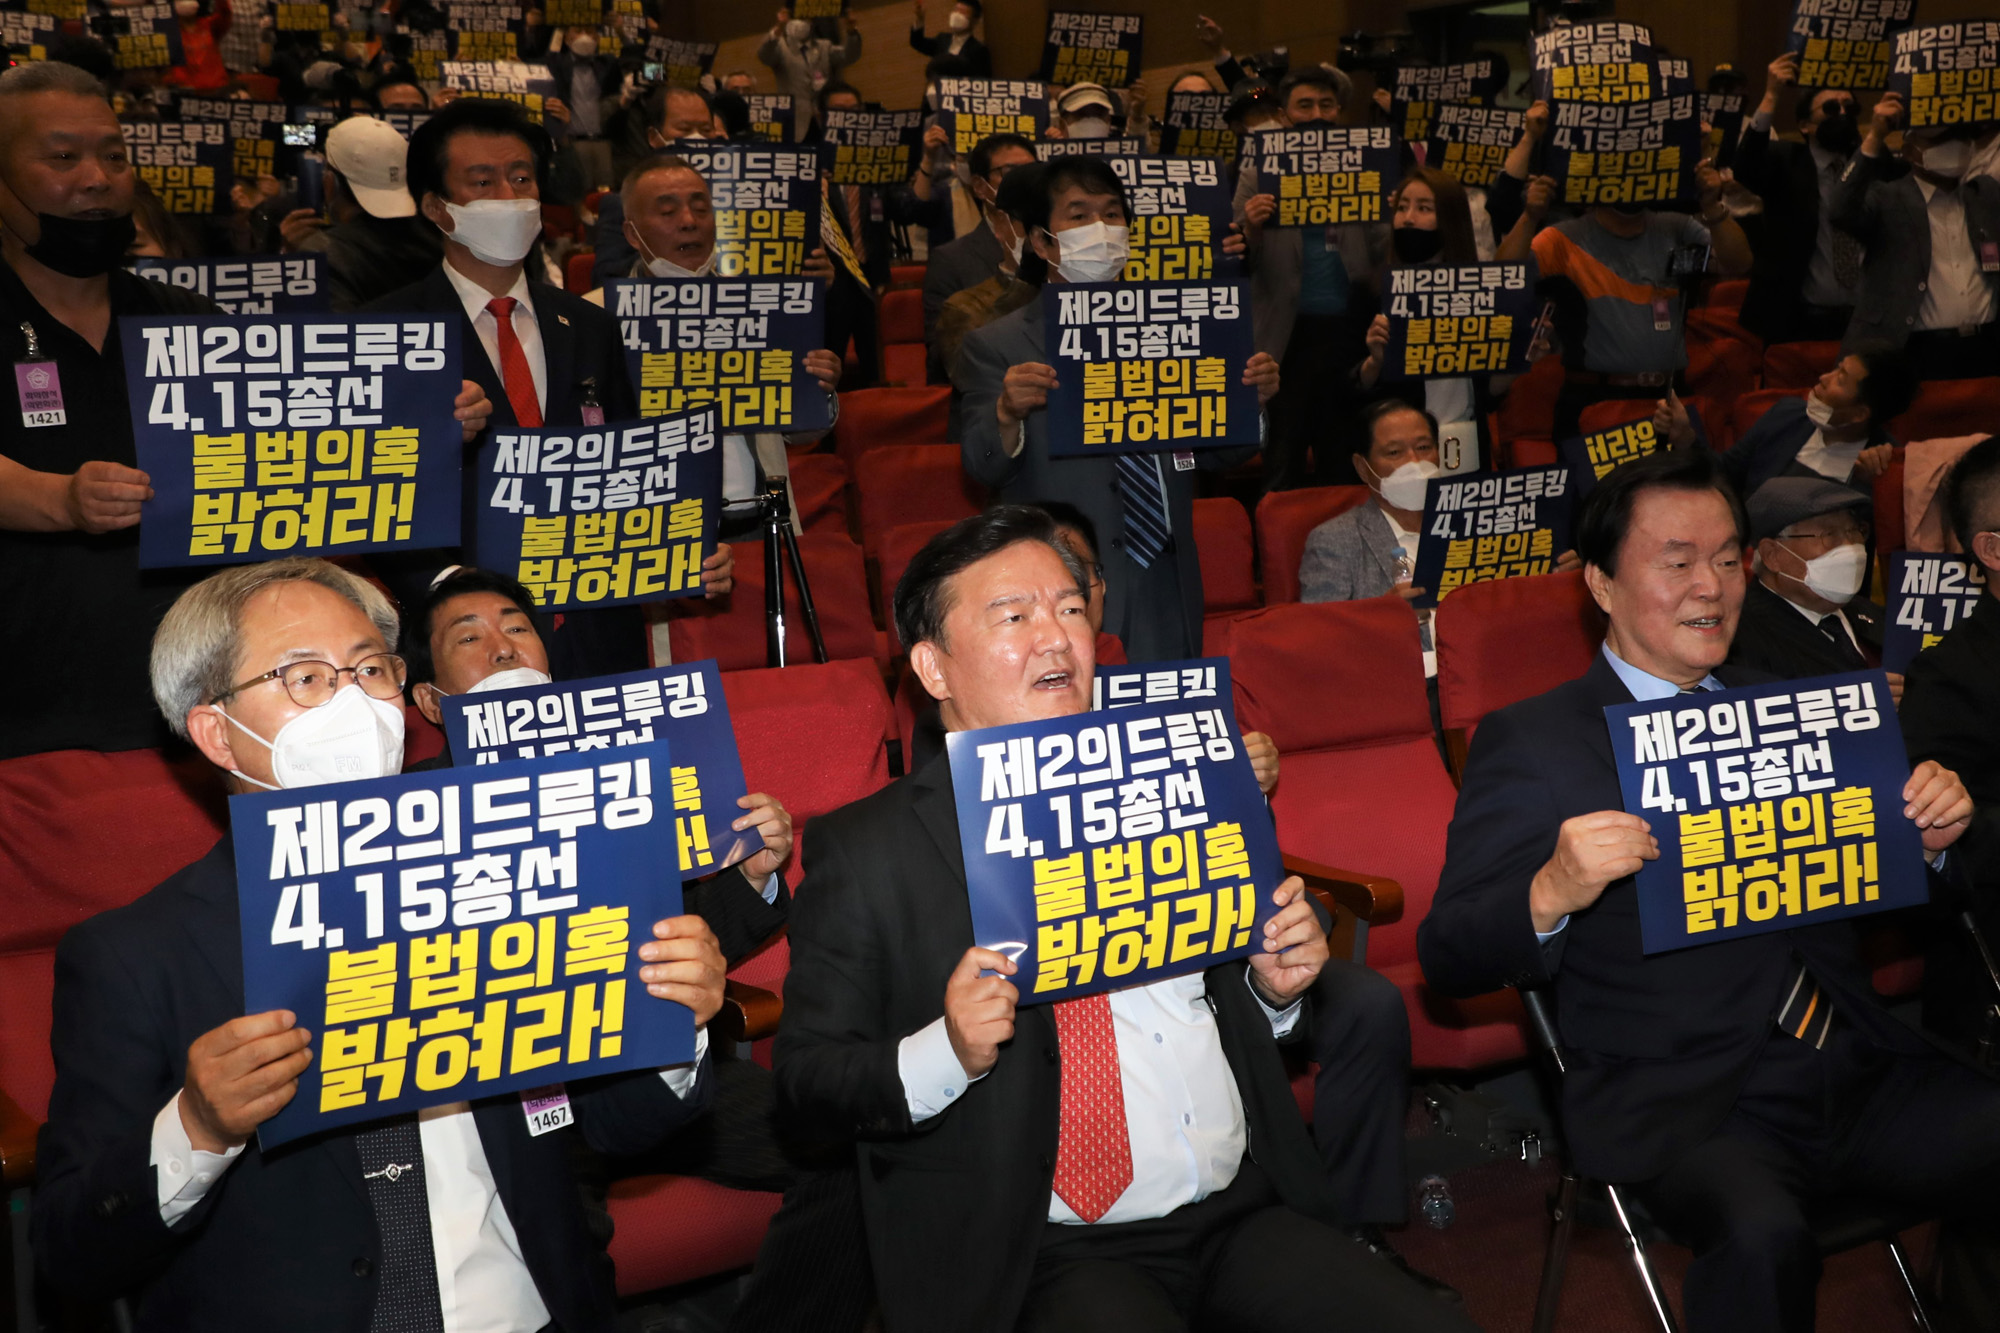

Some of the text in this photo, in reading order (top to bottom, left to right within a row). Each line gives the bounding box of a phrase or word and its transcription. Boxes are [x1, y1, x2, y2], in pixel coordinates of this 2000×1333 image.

[1793, 17, 1886, 41] 4.15총선
[1536, 43, 1632, 71] 4.15총선
[1552, 62, 1650, 88] 불법의혹
[1798, 61, 1889, 88] 밝혀라!
[1894, 44, 1997, 74] 4.15총선
[942, 96, 1021, 115] 4.15총선
[955, 113, 1036, 133] 불법의혹
[1553, 124, 1664, 151] 4.15총선
[1262, 150, 1363, 175] 4.15총선
[1568, 146, 1680, 176] 불법의혹
[1280, 171, 1381, 198] 불법의혹
[1565, 172, 1679, 203] 밝혀라!
[1279, 195, 1381, 226] 밝혀라!
[1391, 292, 1495, 318] 4.15총선
[620, 316, 768, 351] 4.15총선
[1058, 323, 1201, 361] 4.15총선
[1406, 315, 1513, 343] 불법의혹
[641, 349, 793, 388] 불법의혹
[1405, 342, 1510, 375] 밝혀라!
[1083, 357, 1226, 400] 불법의혹
[29, 412, 61, 425] 1421
[148, 375, 383, 431] 4.15총선
[1083, 396, 1227, 445] 밝혀라!
[192, 426, 420, 490] 불법의혹
[490, 461, 677, 515] 4.15총선
[189, 483, 417, 556] 밝혀라!
[520, 498, 704, 558] 불법의혹
[1430, 502, 1537, 538] 4.15총선
[1444, 528, 1553, 567] 불법의혹
[1641, 739, 1836, 813] 4.15총선
[985, 769, 1208, 858] 4.15총선
[1679, 786, 1875, 868] 불법의혹
[1033, 822, 1251, 922] 불법의혹
[1682, 842, 1879, 934] 밝혀라!
[271, 840, 578, 951] 4.15총선
[1033, 883, 1256, 993] 밝혀라!
[325, 905, 630, 1026] 불법의혹
[319, 978, 627, 1113] 밝혀라!
[533, 1107, 566, 1131] 1467
